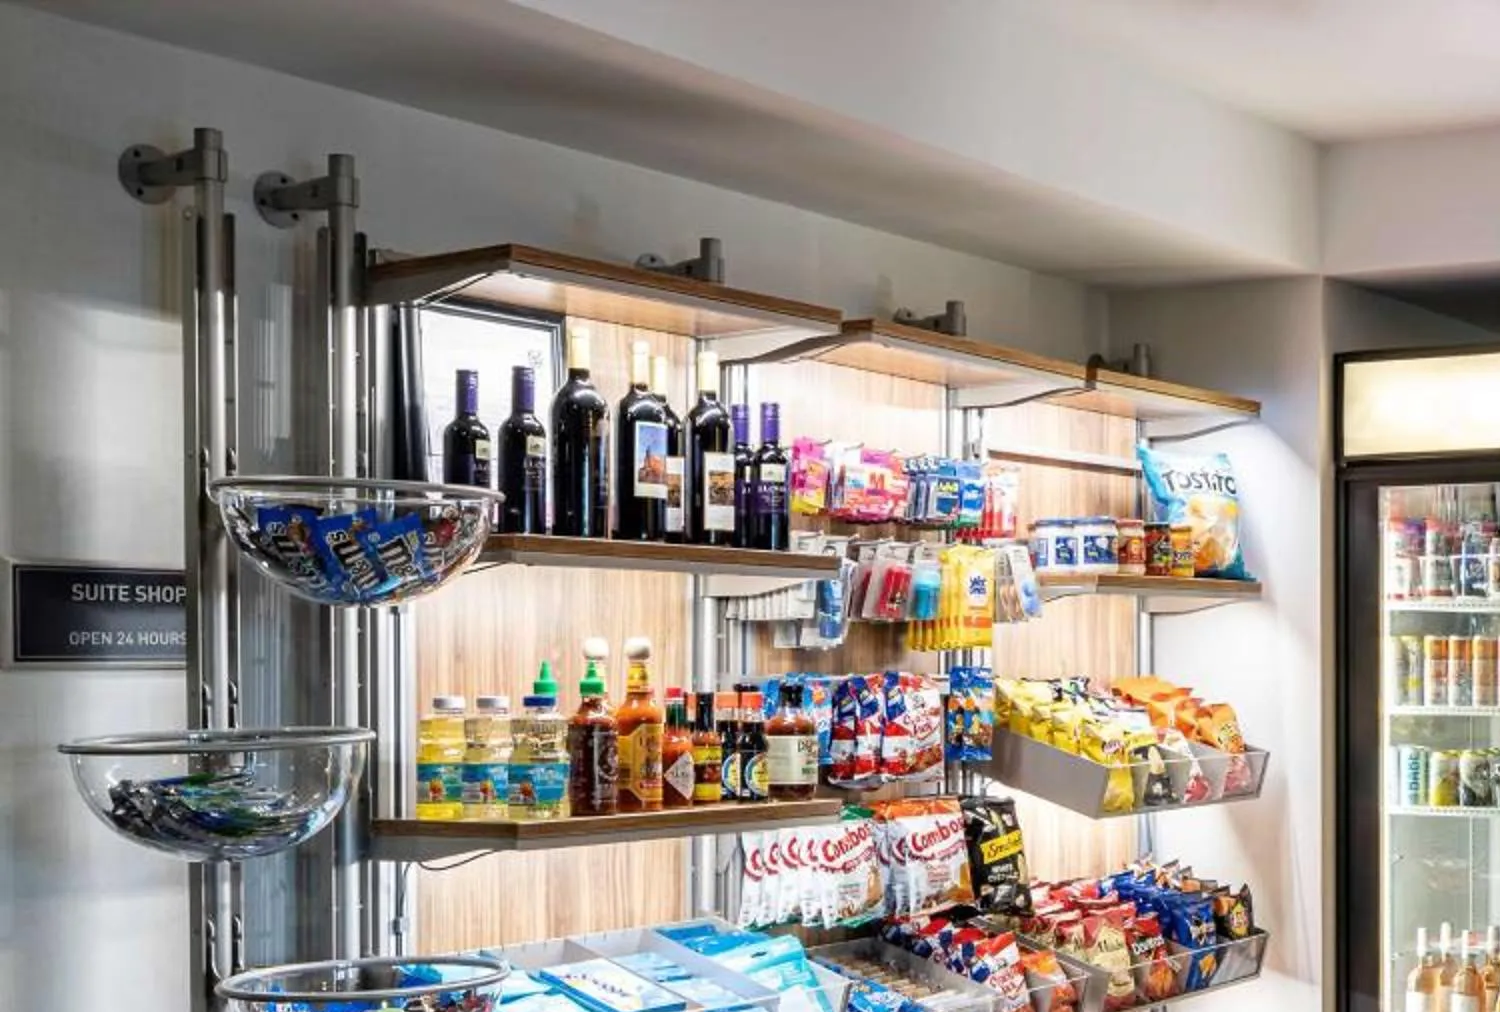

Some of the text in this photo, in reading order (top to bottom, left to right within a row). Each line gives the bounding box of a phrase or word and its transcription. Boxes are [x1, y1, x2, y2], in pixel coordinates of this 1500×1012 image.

[71, 583, 187, 603] SUITE SHOP
[69, 631, 187, 646] OPEN 24 HOURS
